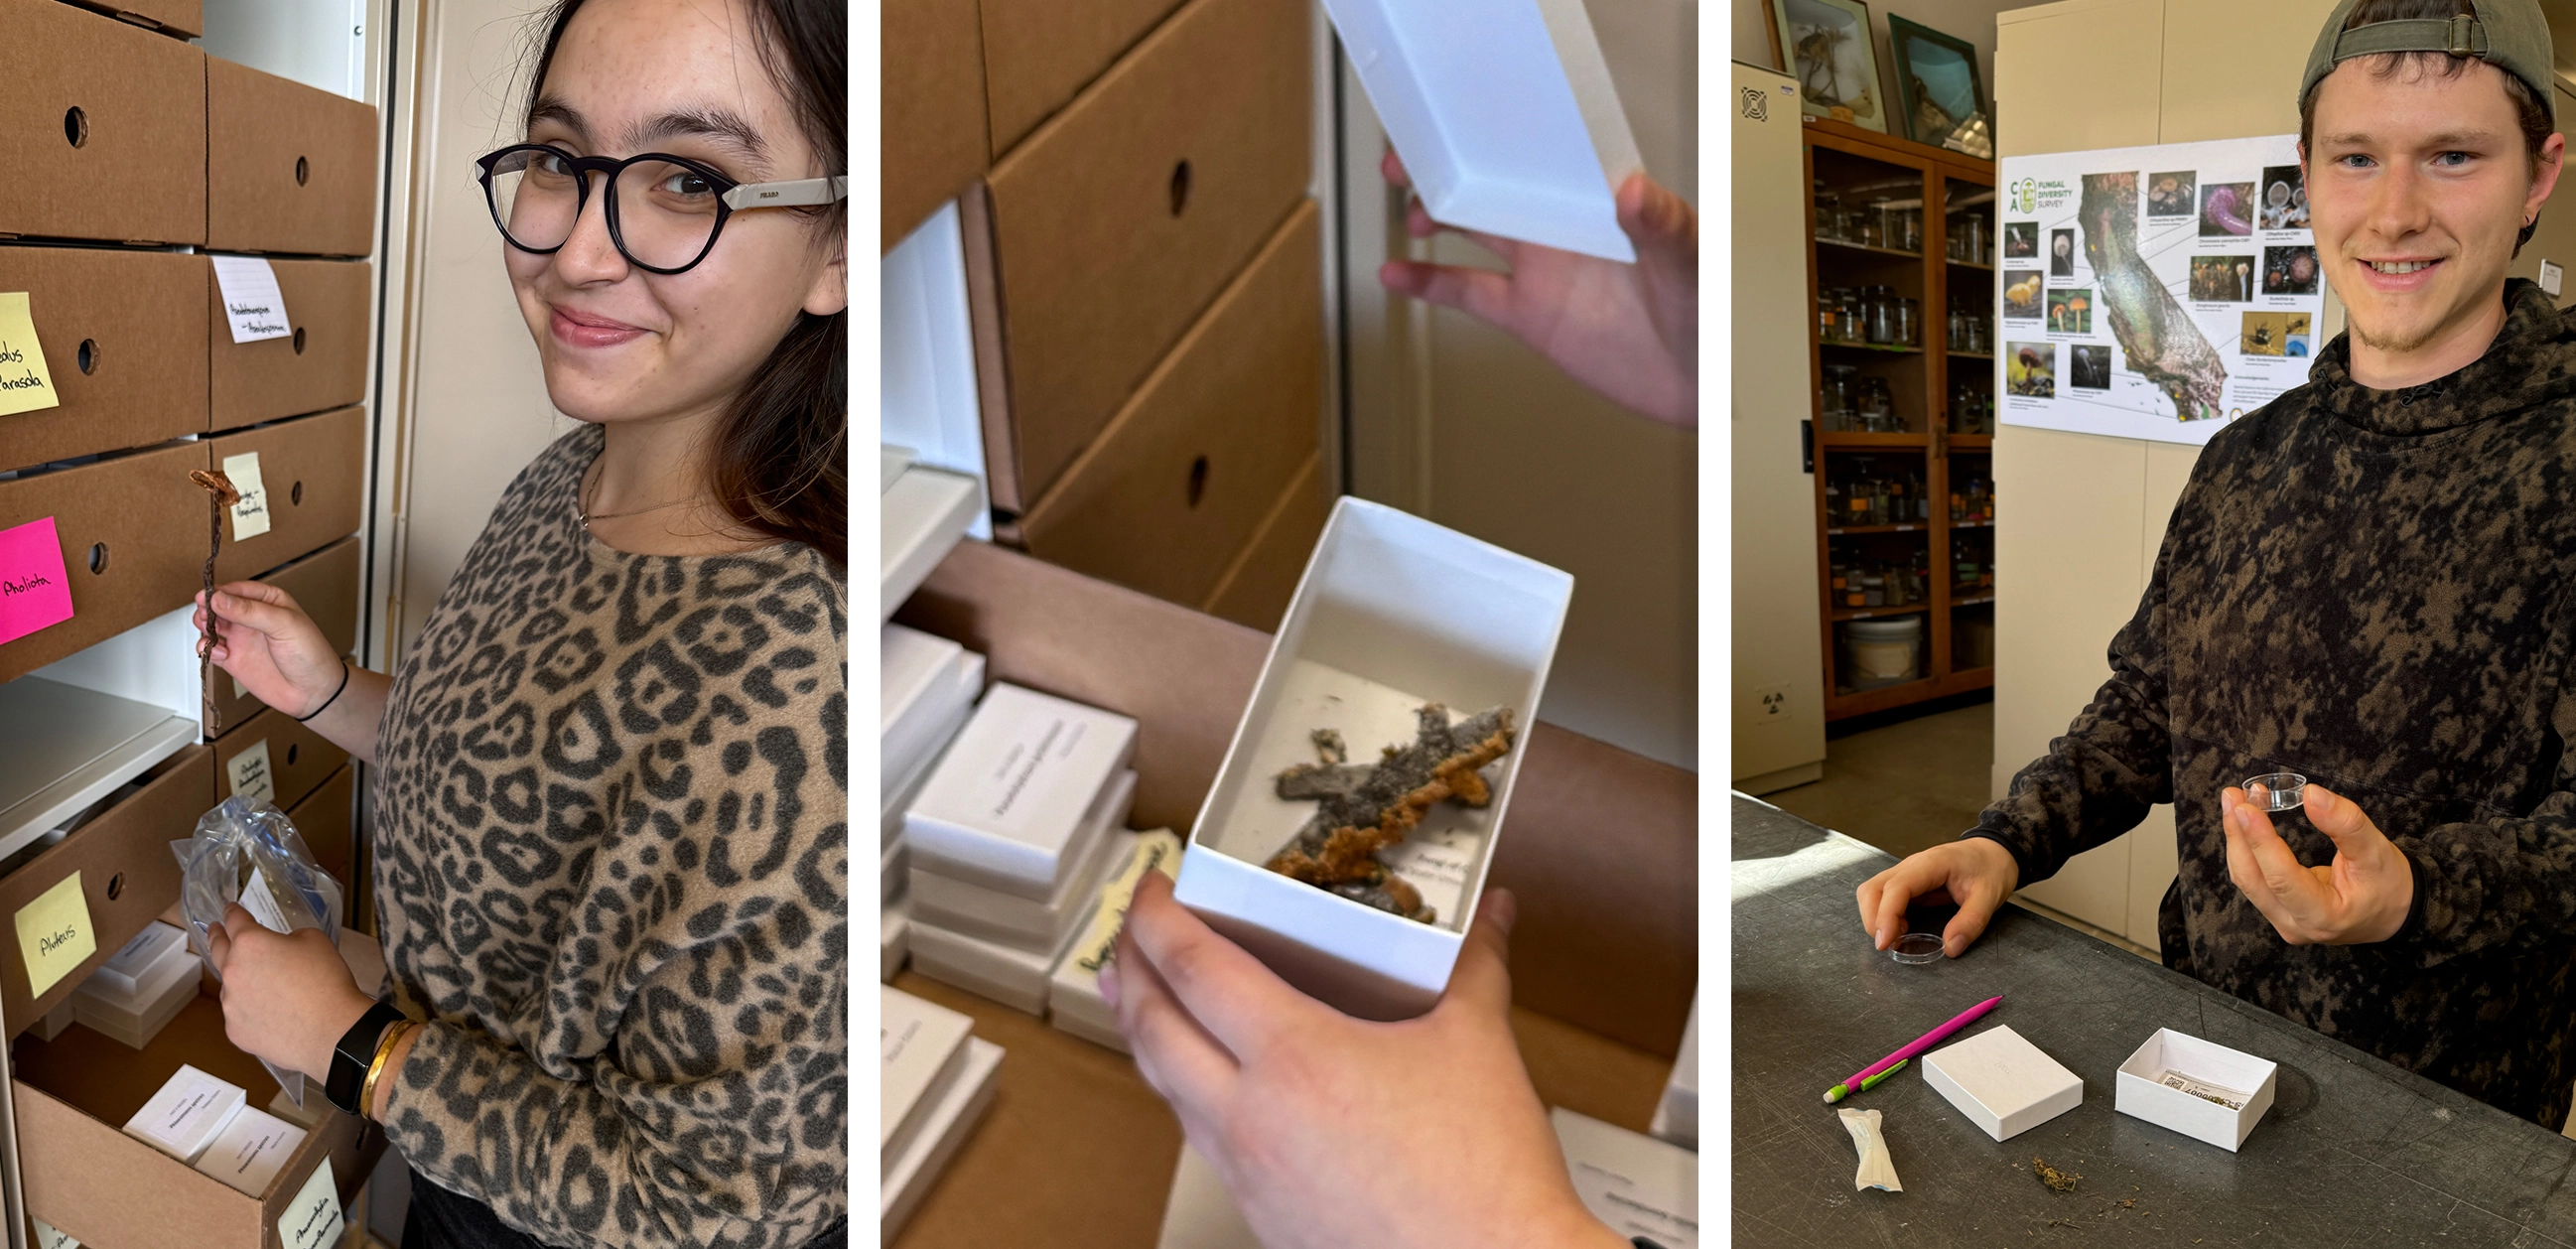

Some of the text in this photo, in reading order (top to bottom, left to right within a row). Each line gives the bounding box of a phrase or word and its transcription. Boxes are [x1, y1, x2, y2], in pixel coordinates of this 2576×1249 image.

[2010, 181, 2019, 196] C
[2038, 181, 2065, 190] FUNGAL
[2038, 190, 2073, 199] DIVERSITY
[2009, 198, 2019, 211] A
[2037, 200, 2064, 208] SURVEY
[3, 573, 52, 597] Pholiota
[40, 923, 76, 957] Pluteus
